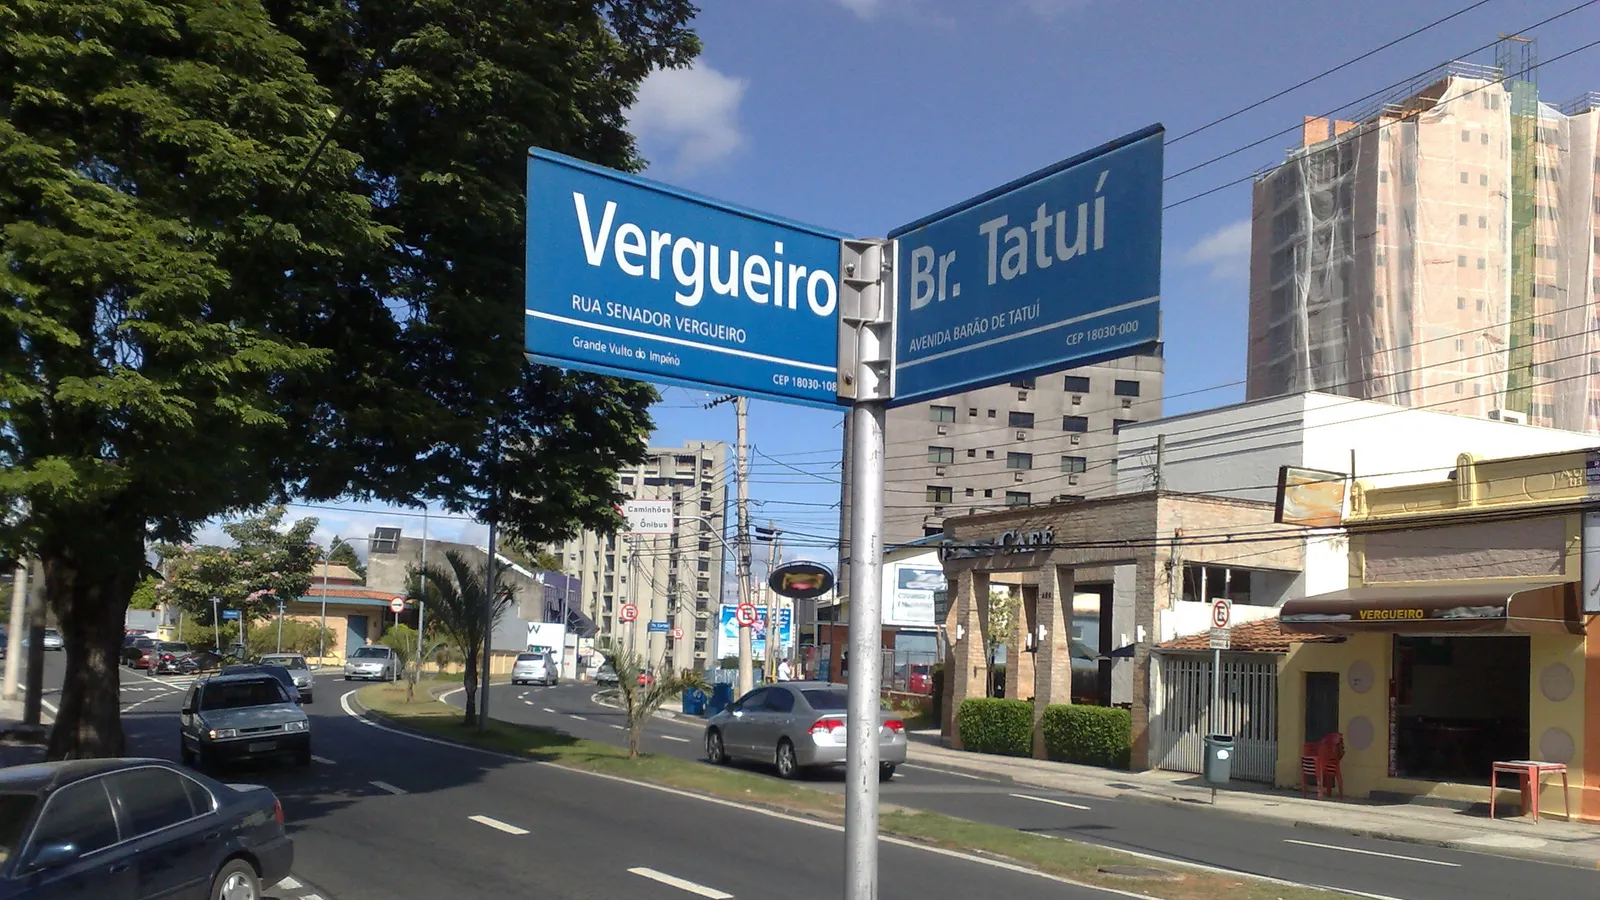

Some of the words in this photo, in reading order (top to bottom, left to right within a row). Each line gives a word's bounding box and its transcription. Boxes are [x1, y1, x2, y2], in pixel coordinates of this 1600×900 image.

[909, 244, 961, 311] Br.
[979, 168, 1110, 286] Tatuí
[572, 191, 837, 317] Vergueiro
[571, 294, 602, 315] RUA
[606, 302, 672, 329] SENADOR
[674, 315, 747, 344] VERGUEIRO
[908, 329, 951, 353] AVENIDA
[953, 315, 989, 341] BARÃO
[991, 312, 1006, 330] DE
[1008, 297, 1041, 326] TATUÍ
[1065, 332, 1084, 346] CEP
[1086, 319, 1140, 342] 18030-000
[572, 336, 607, 353] Grande
[608, 342, 633, 358] Vulto
[635, 347, 646, 360] do
[772, 373, 790, 386] CEP
[791, 376, 837, 392] 18030-108
[627, 505, 671, 513] Caminhões
[639, 518, 668, 528] Ônibus
[1359, 609, 1424, 620] VERGUEIRO
